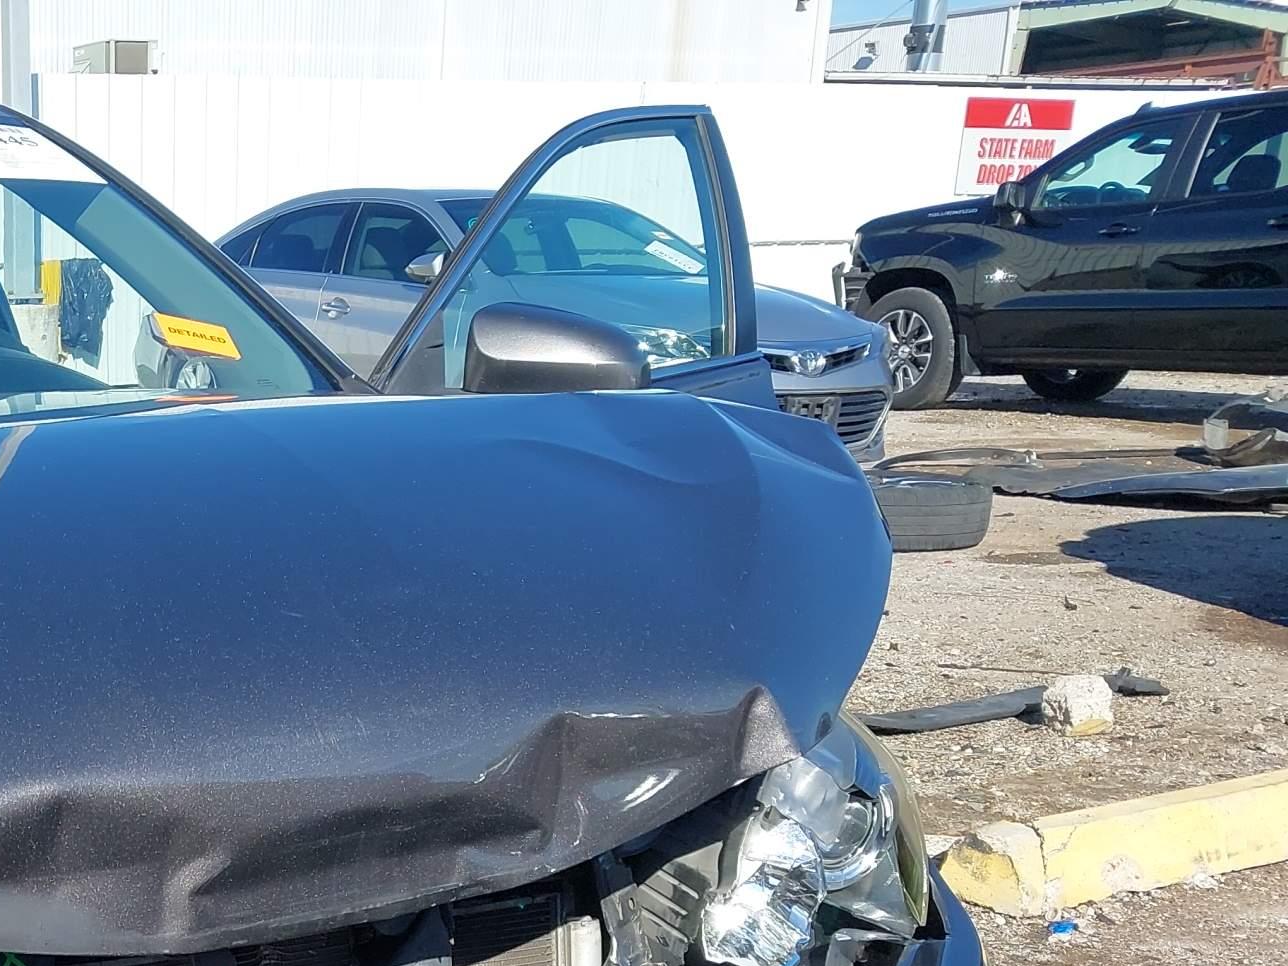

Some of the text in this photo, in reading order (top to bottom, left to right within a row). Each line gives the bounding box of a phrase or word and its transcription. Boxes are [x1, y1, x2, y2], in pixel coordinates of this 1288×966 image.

[977, 137, 1056, 160] STATE FARM
[976, 164, 1015, 185] DROP
[168, 326, 226, 344] DETAILED
